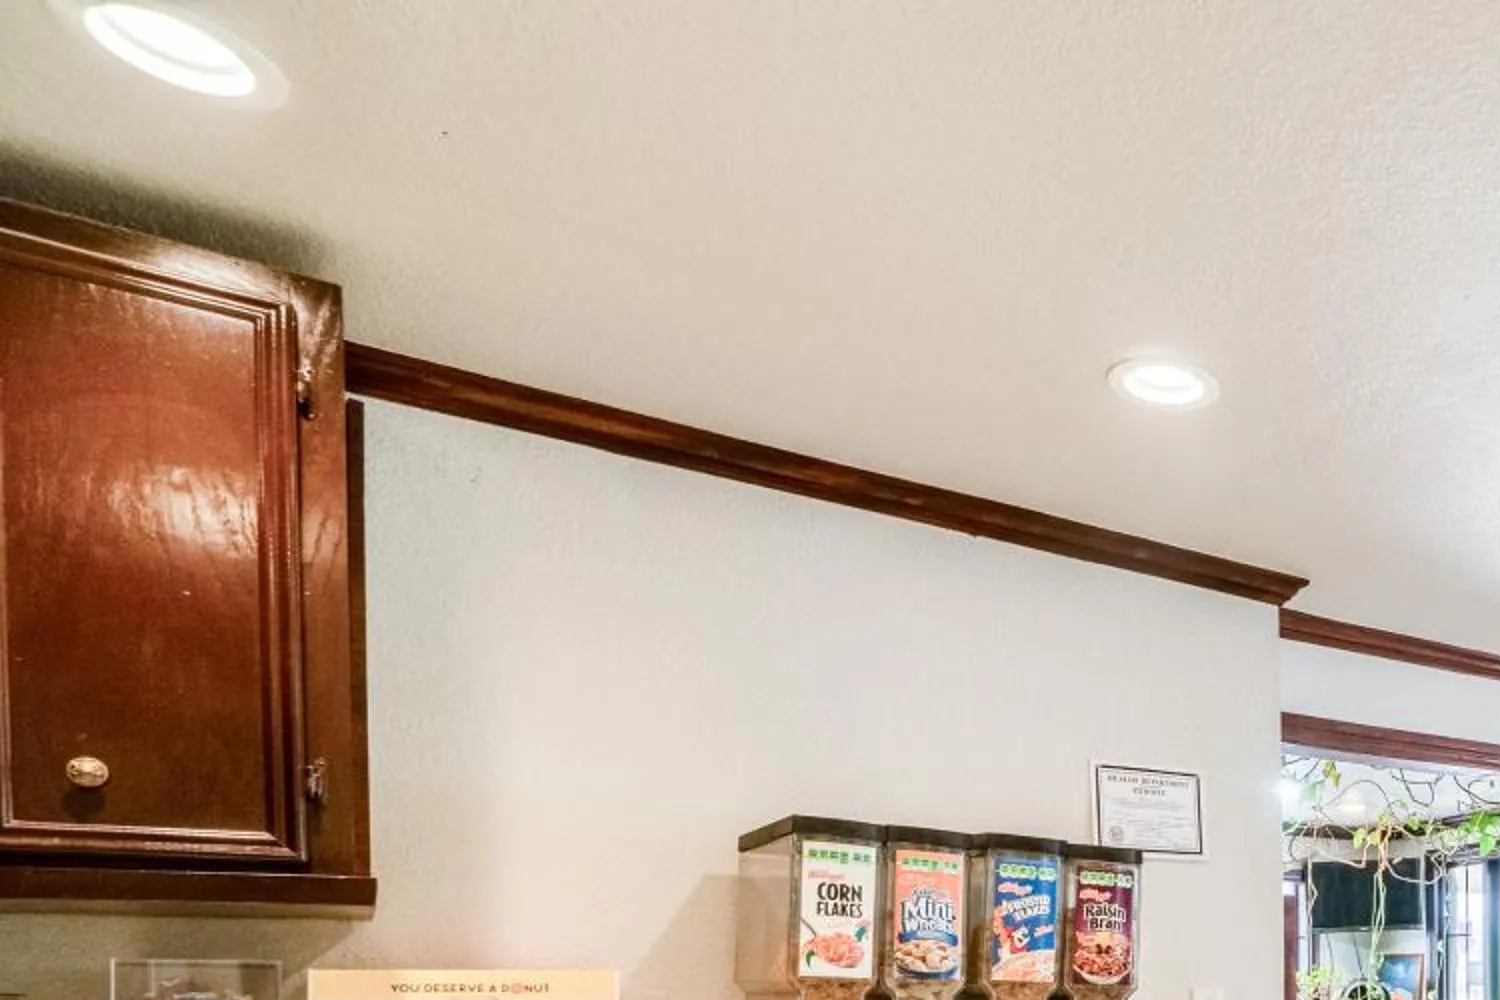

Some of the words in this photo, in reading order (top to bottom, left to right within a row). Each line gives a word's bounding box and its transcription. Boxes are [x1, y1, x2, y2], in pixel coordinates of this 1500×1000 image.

[816, 881, 863, 902] CORN
[816, 901, 863, 918] FLAKES
[1084, 903, 1126, 920] Raisin
[1089, 917, 1122, 930] Bran
[391, 983, 420, 993] YOU
[424, 983, 486, 993] DESERVE
[488, 983, 498, 993] A
[501, 983, 550, 993] DONUT
